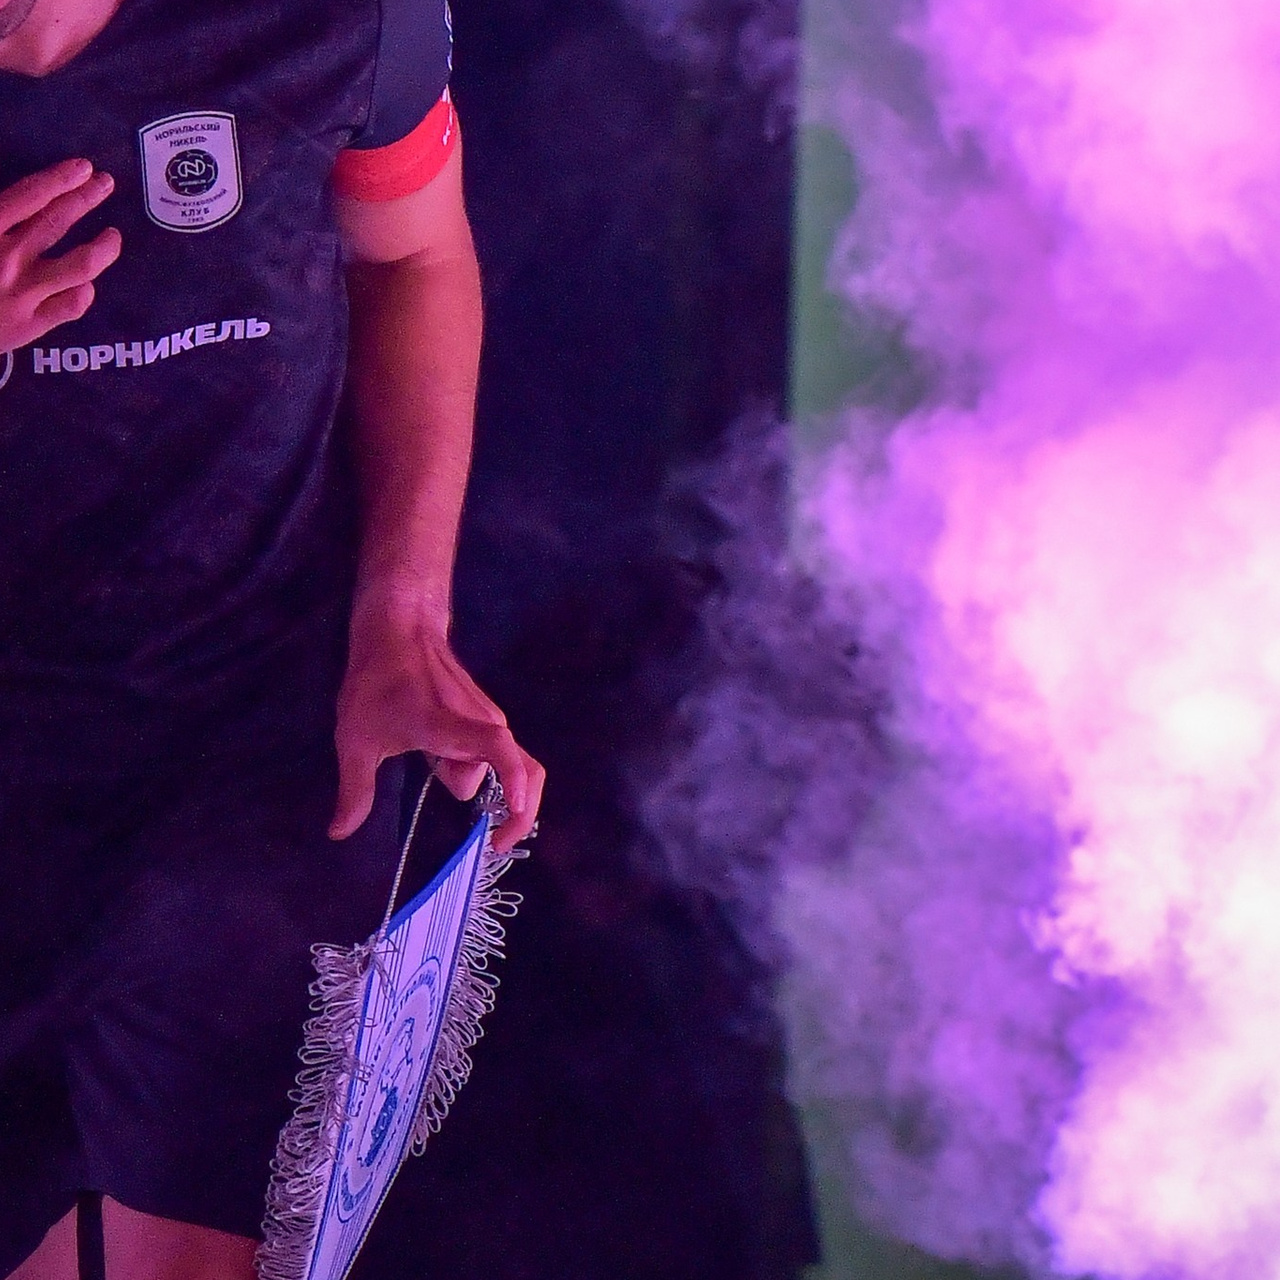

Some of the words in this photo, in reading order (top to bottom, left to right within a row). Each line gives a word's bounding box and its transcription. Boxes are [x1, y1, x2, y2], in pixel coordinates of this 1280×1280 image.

[154, 122, 221, 142] НОРИЛЬСКИЙ
[169, 136, 208, 148] НИКЕЛЬ
[180, 207, 210, 218] КЛУБ
[33, 317, 272, 375] НОРНИКЕЛЬ
